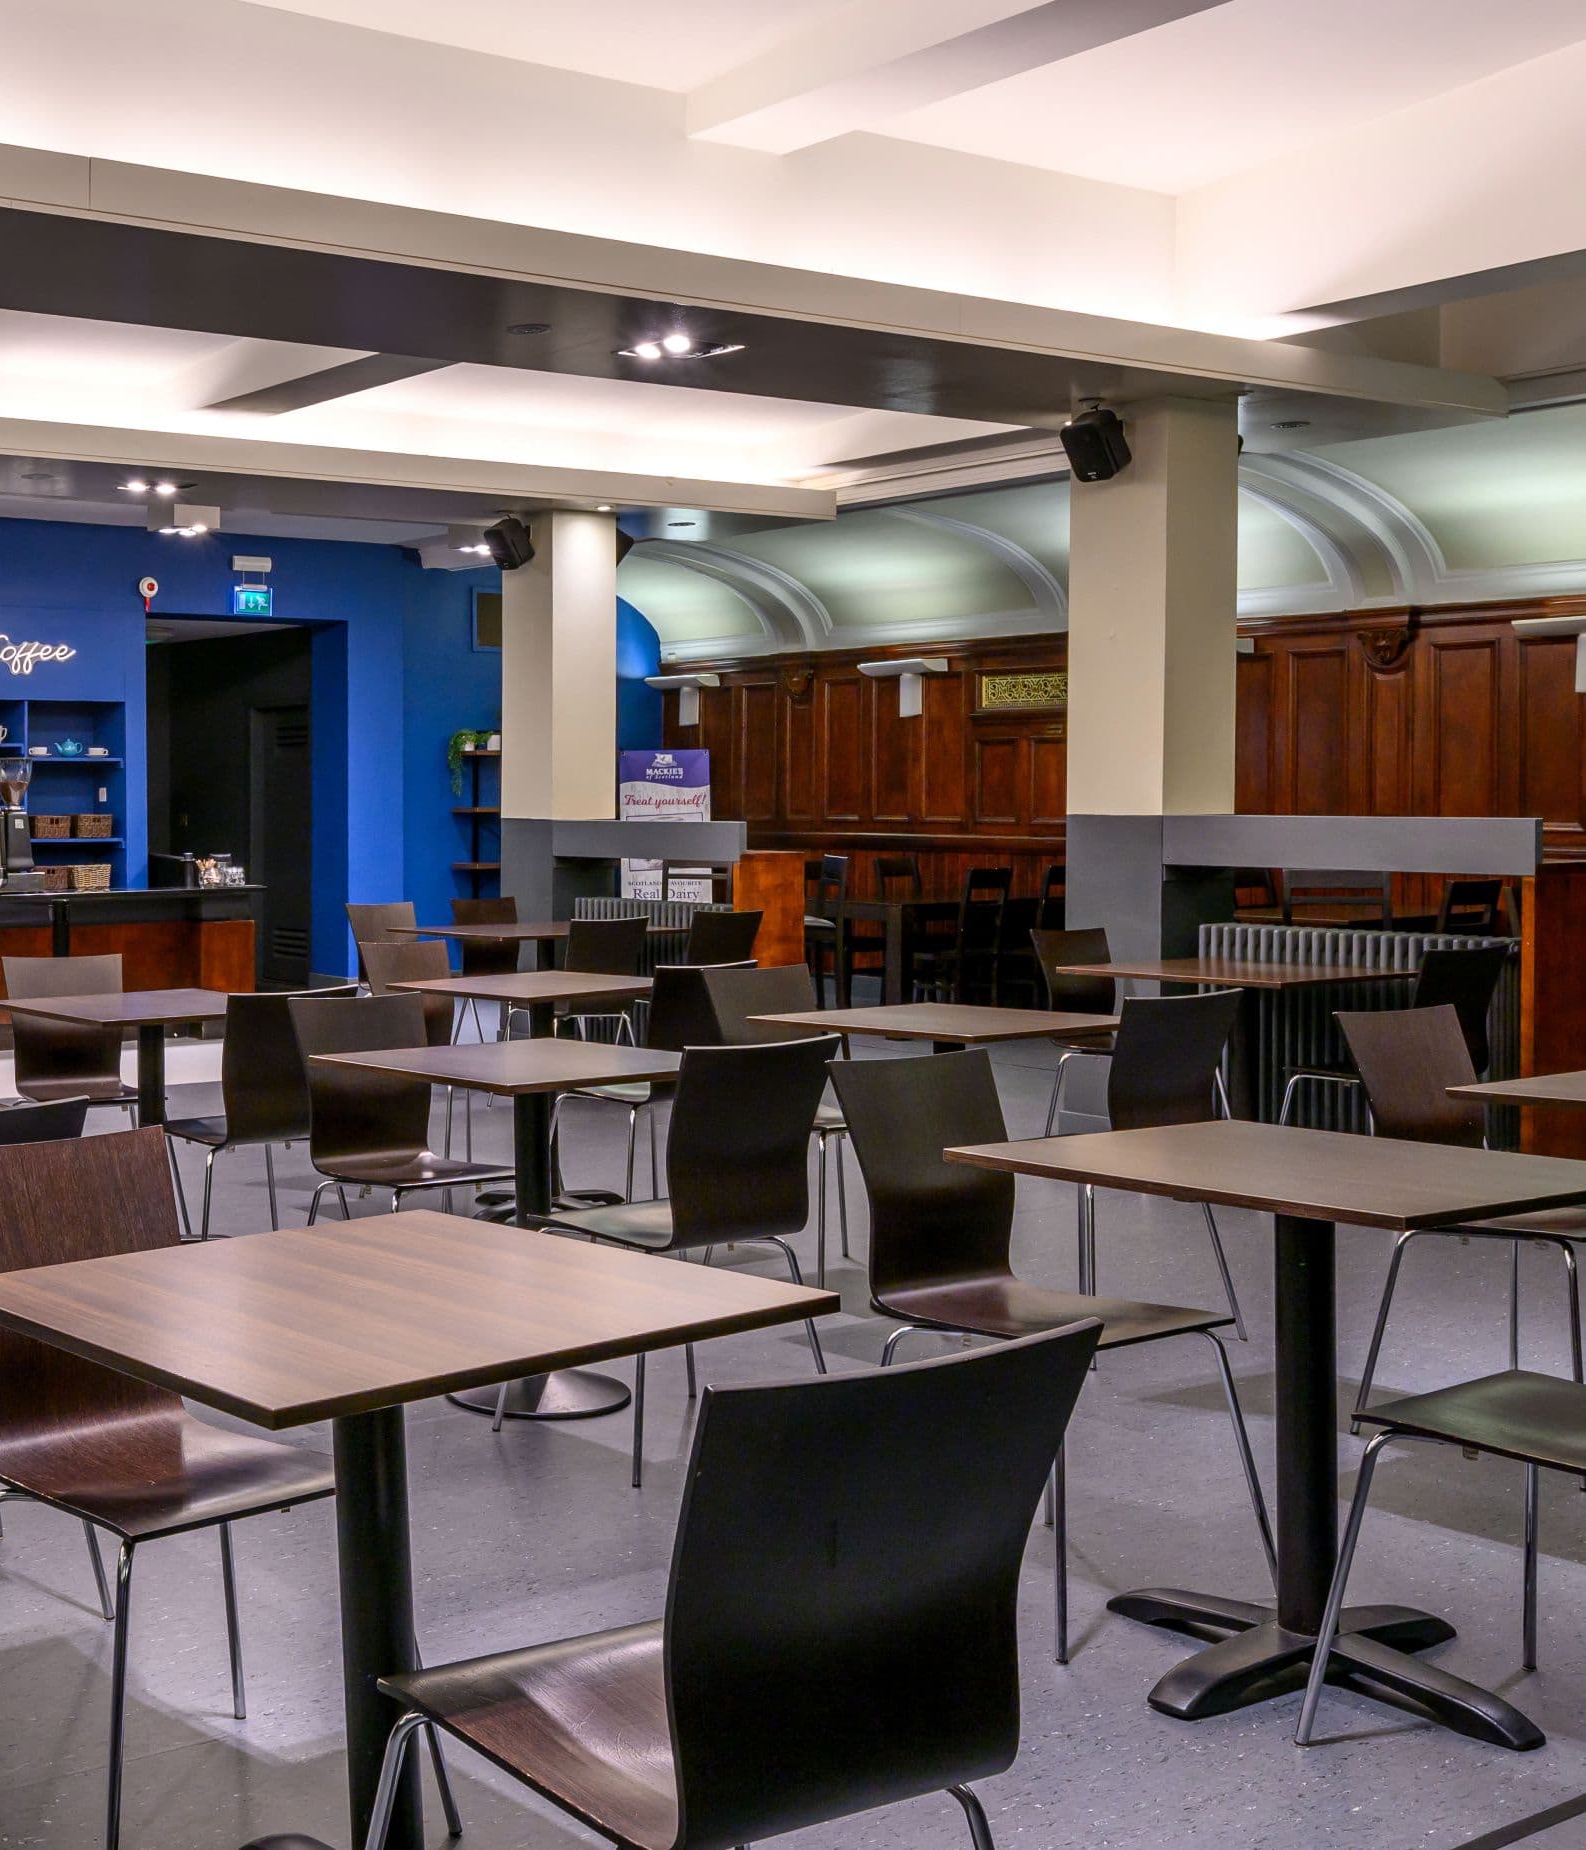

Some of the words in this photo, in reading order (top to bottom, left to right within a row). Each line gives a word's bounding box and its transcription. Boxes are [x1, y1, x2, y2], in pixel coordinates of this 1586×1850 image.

[624, 795, 652, 805] Treat
[654, 794, 706, 809] yourself!
[633, 888, 660, 899] Real
